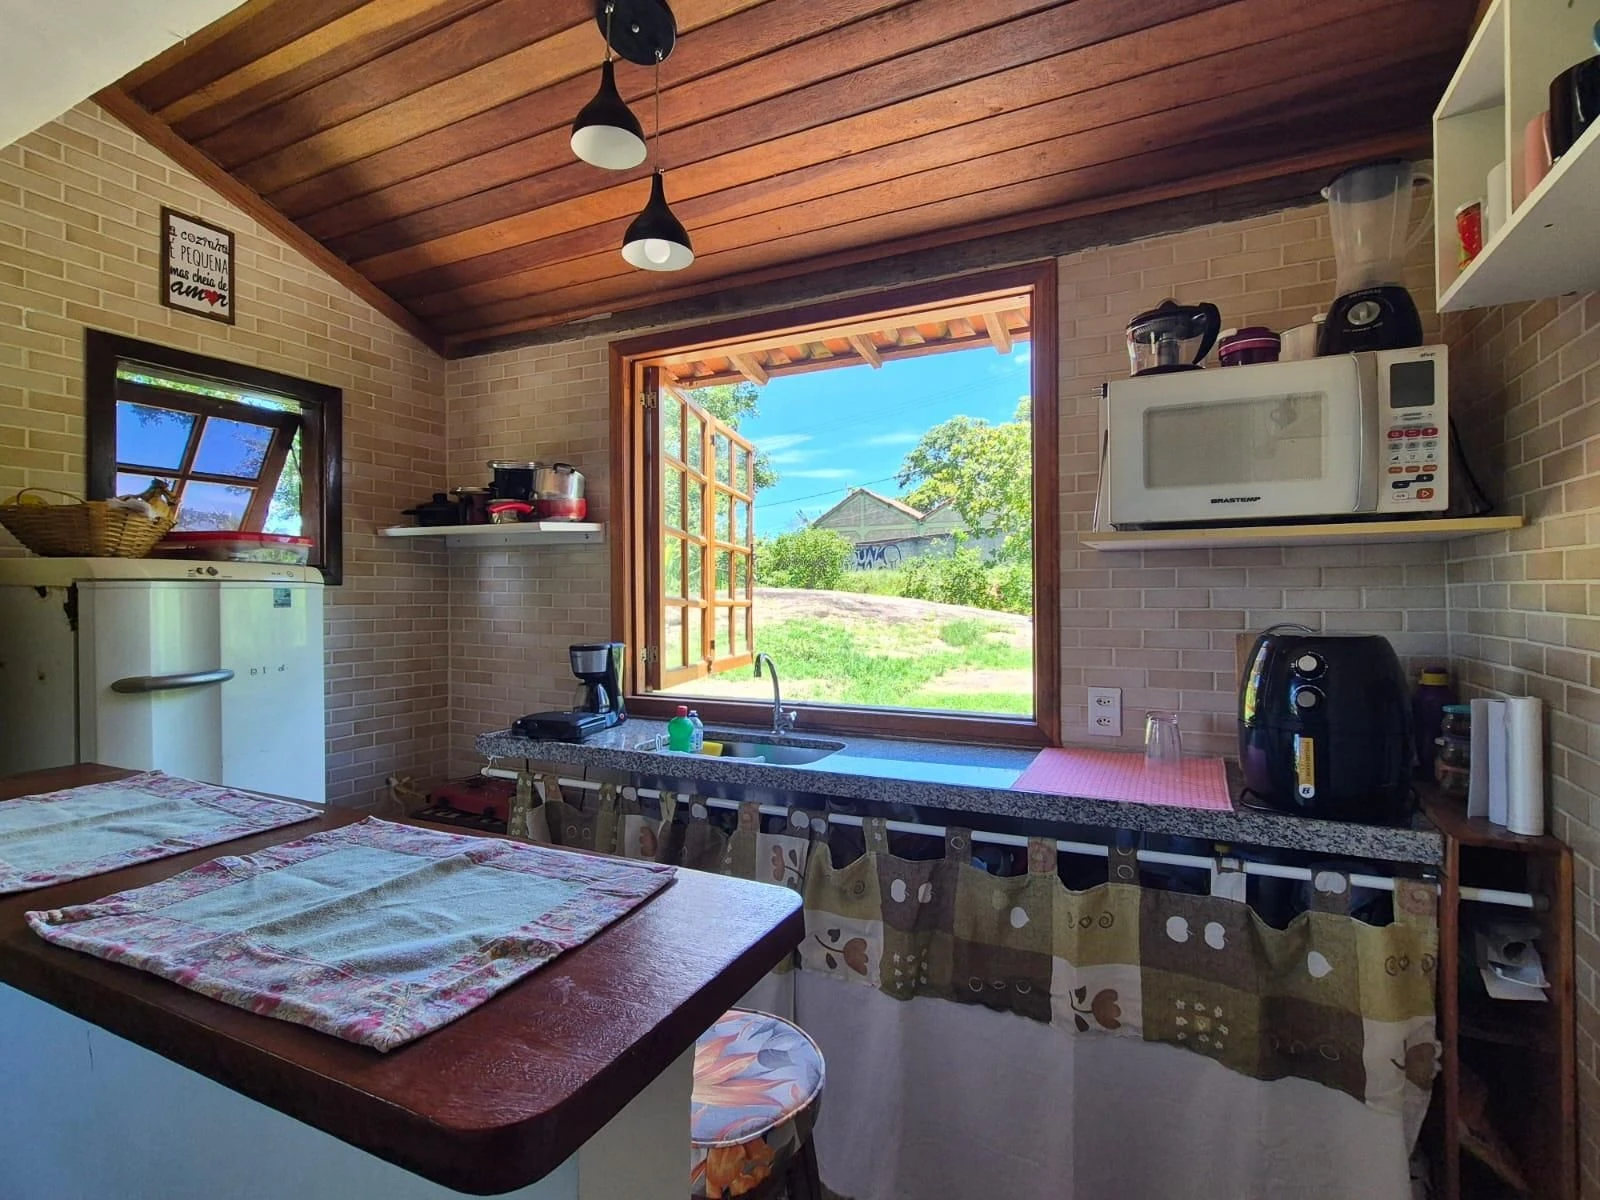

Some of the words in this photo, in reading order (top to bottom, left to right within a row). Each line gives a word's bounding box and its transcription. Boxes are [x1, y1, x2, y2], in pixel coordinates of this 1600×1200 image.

[180, 231, 229, 255] cozinha
[181, 245, 228, 275] PEQUENA
[169, 266, 190, 281] mas
[192, 267, 216, 288] cheia
[217, 276, 229, 292] de
